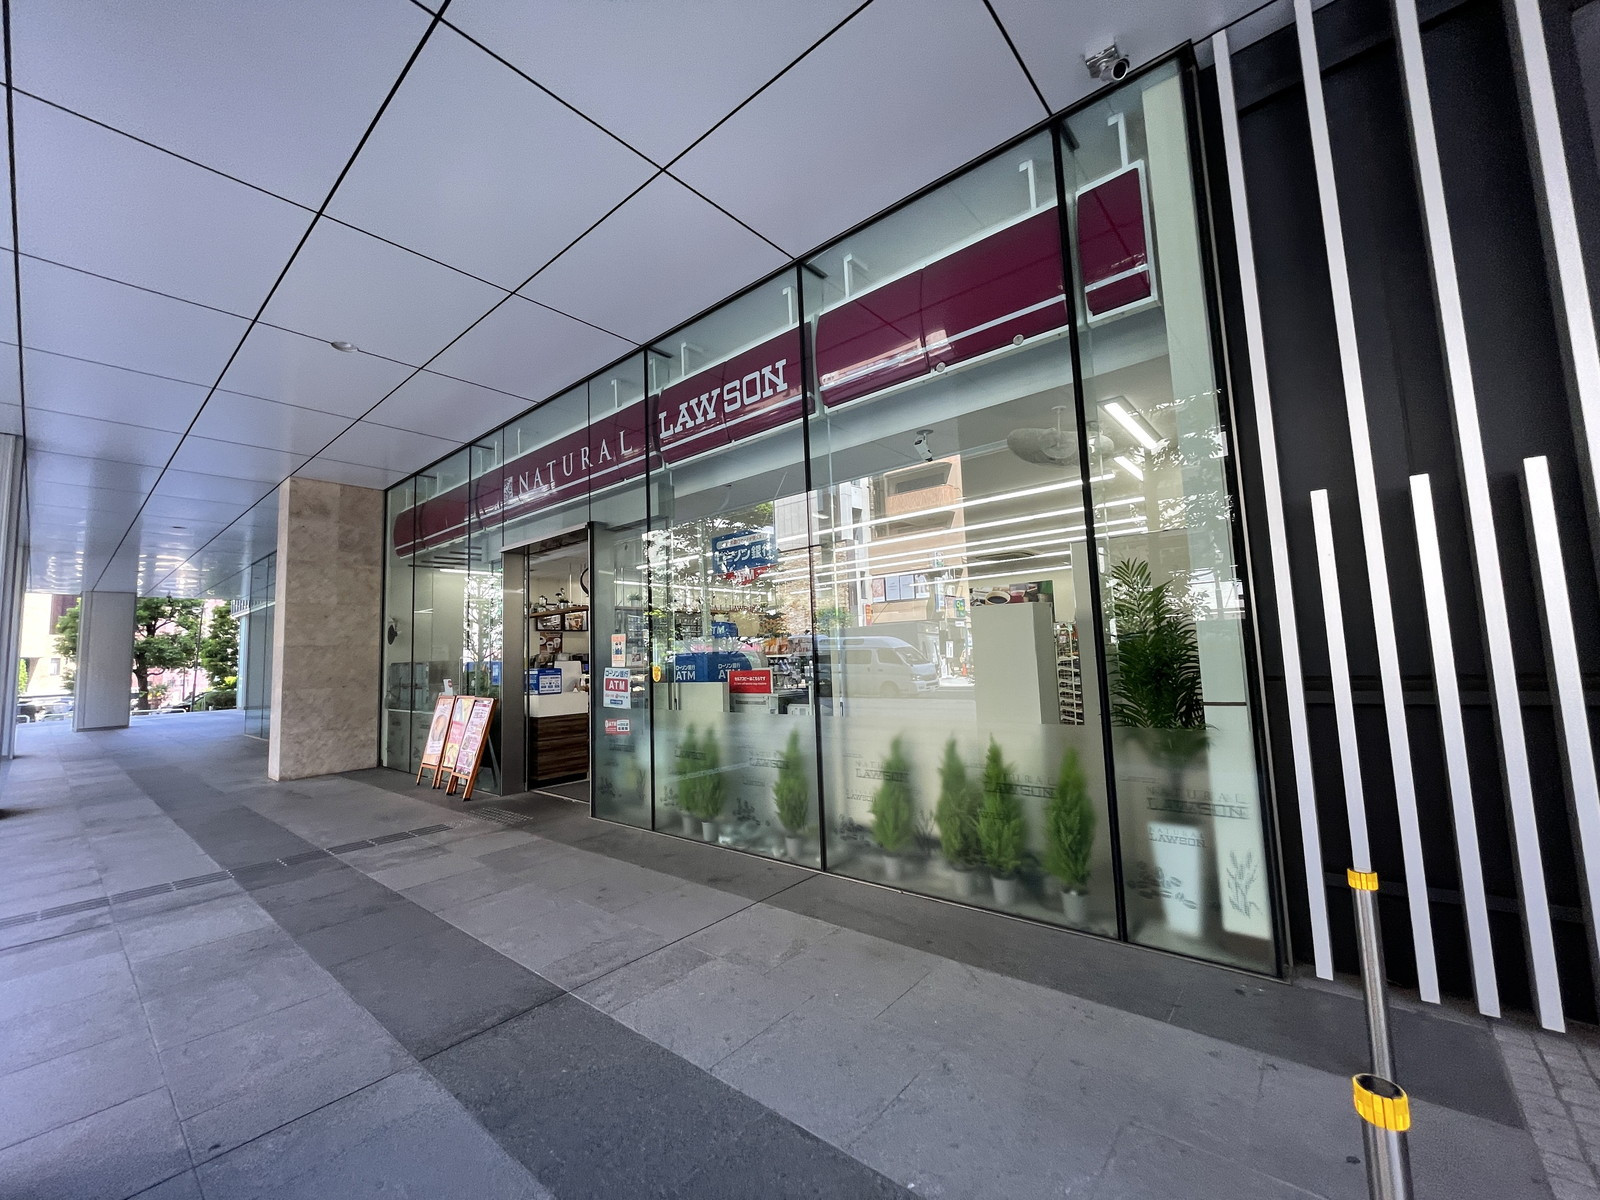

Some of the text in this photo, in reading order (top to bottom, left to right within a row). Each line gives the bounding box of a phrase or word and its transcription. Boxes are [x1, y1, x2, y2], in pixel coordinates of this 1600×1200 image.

[518, 359, 788, 494] NATURAL LAWSON
[675, 671, 696, 680] ATM
[608, 680, 625, 690] ATM
